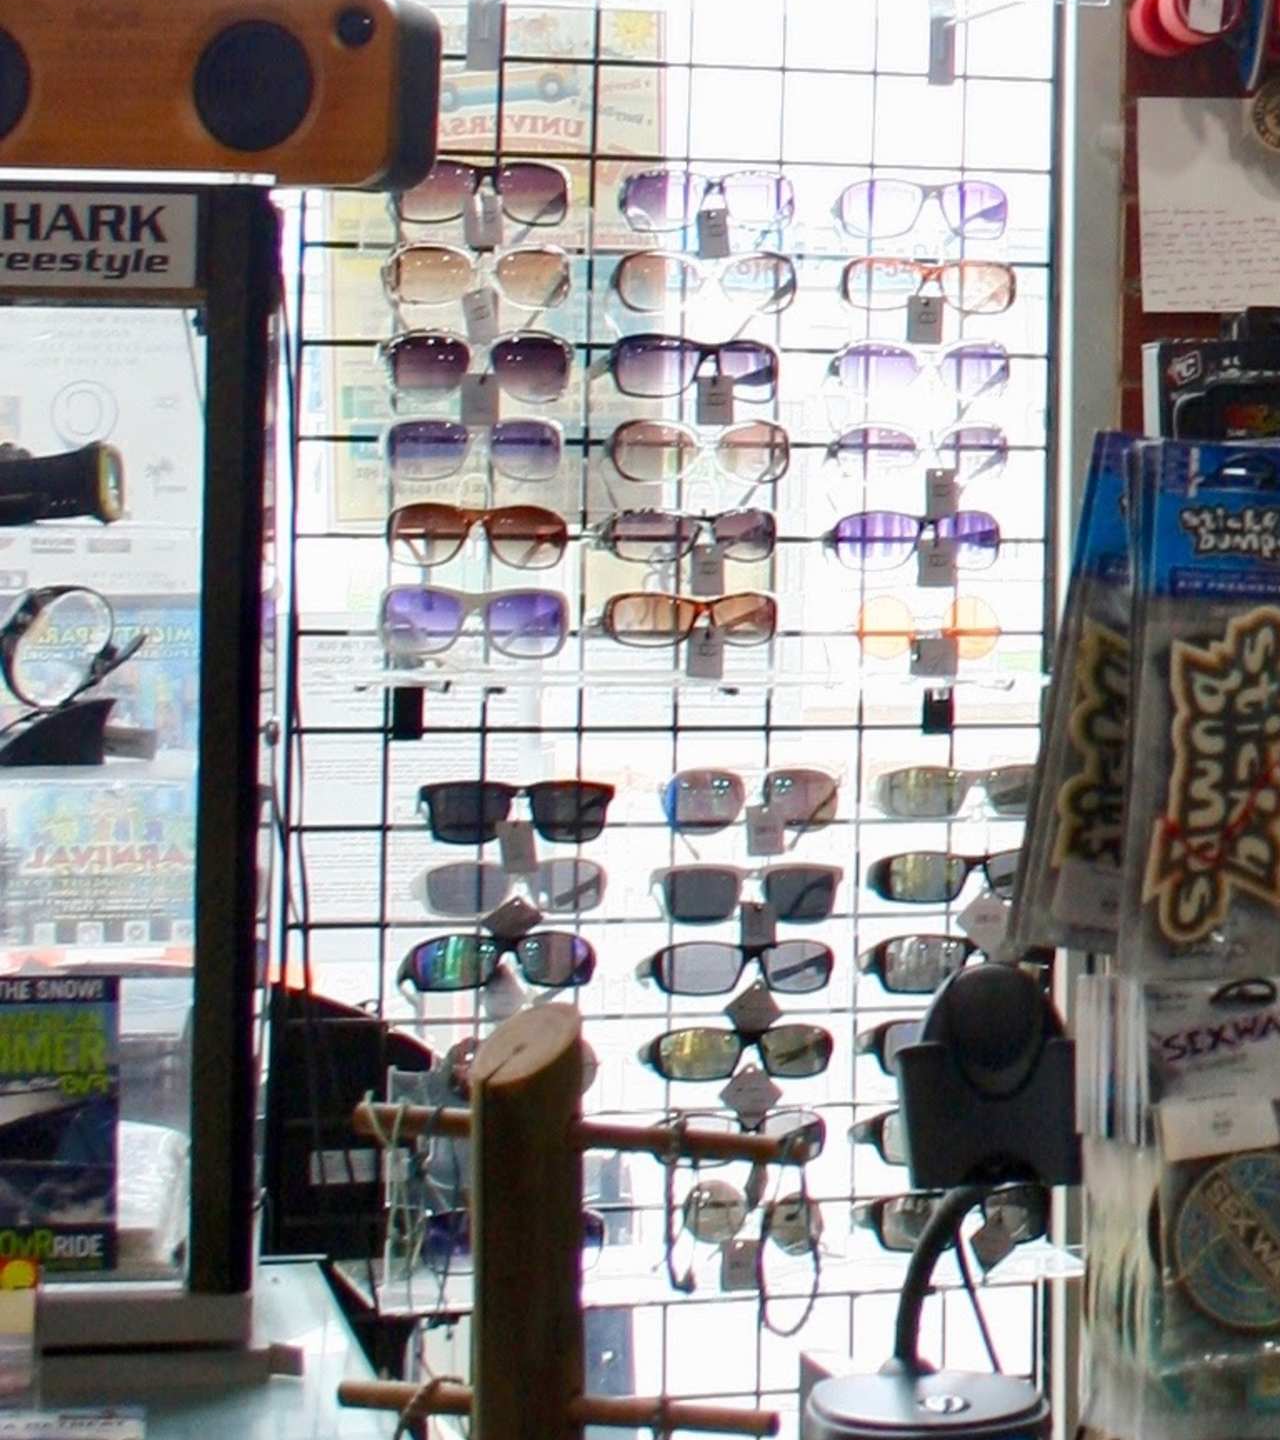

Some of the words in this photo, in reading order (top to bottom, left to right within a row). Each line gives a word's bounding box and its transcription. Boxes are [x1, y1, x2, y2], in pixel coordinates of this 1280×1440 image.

[0, 200, 169, 244] HARK
[0, 245, 170, 277] reestyle
[35, 979, 105, 1001] SNOW!
